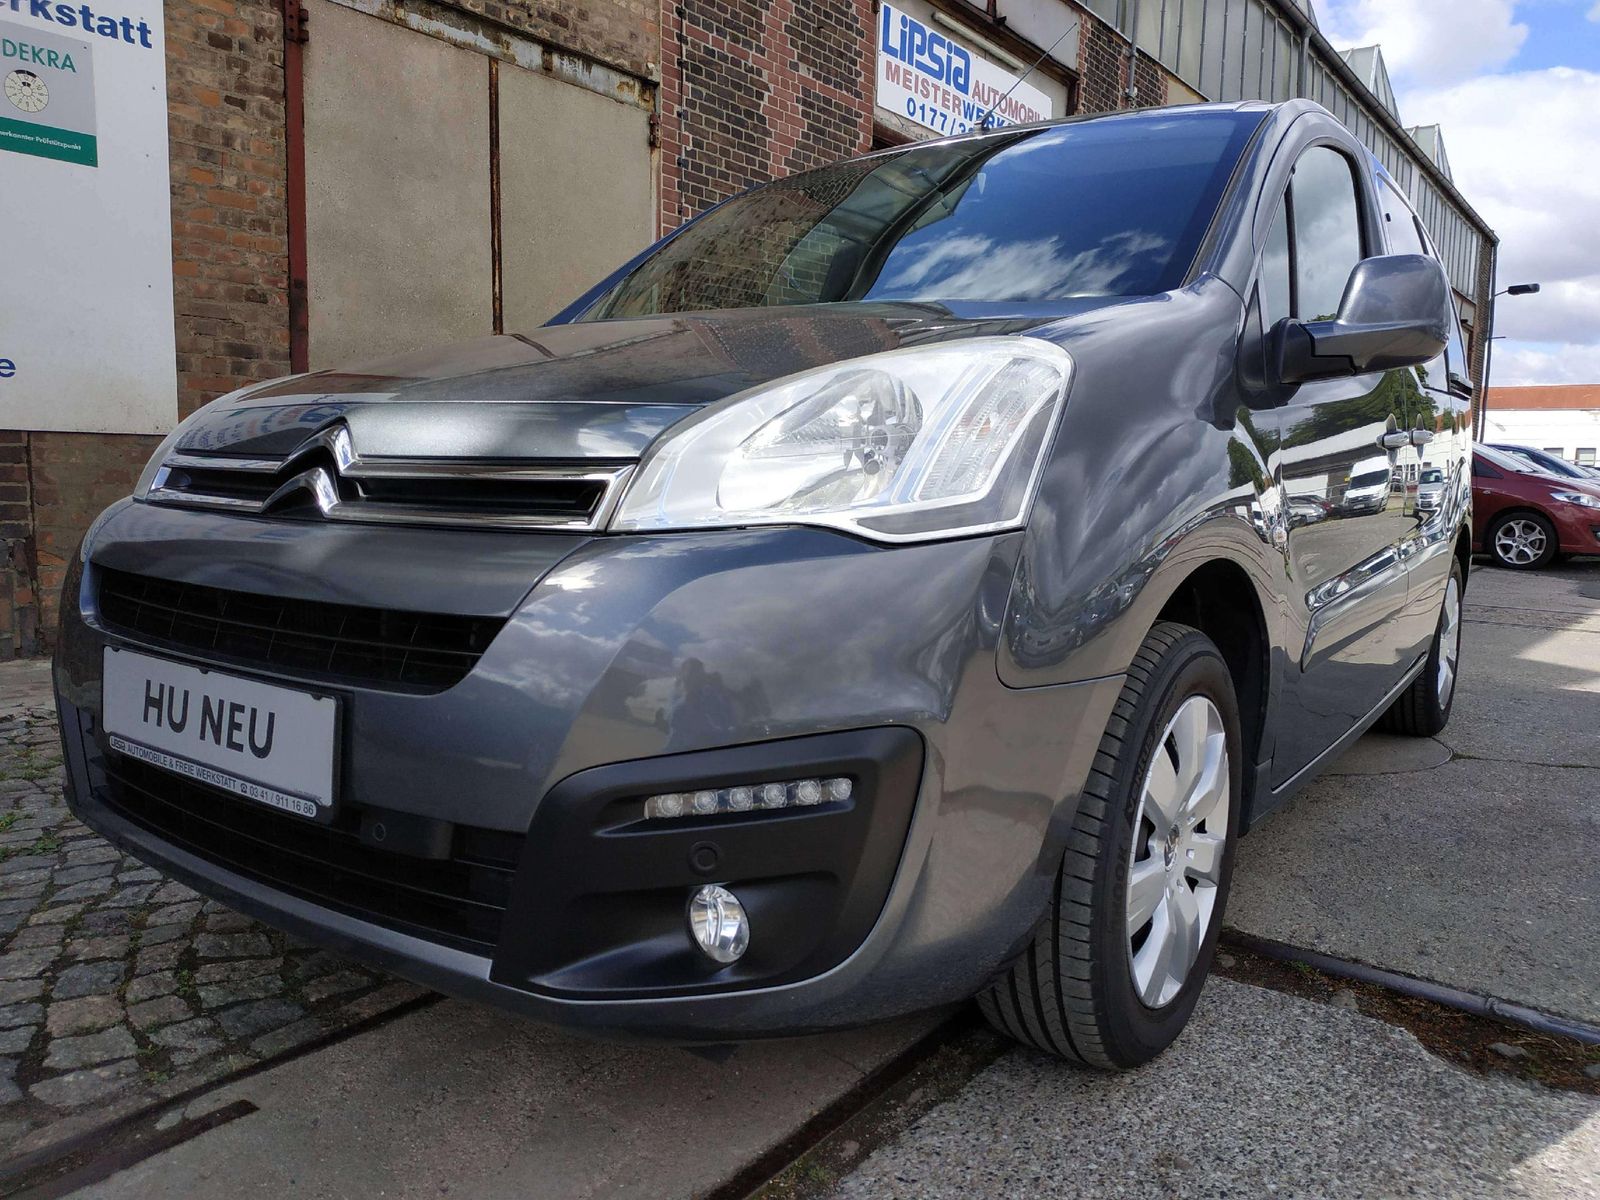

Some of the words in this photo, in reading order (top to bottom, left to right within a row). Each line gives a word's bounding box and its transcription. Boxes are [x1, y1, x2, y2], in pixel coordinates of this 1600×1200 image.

[2, 38, 77, 73] DEKRA
[143, 679, 190, 734] HU
[199, 694, 276, 760] NEU
[127, 744, 168, 767] AUTOMOBILE
[175, 760, 195, 775] FREIE
[195, 765, 237, 790] WERKSTATT
